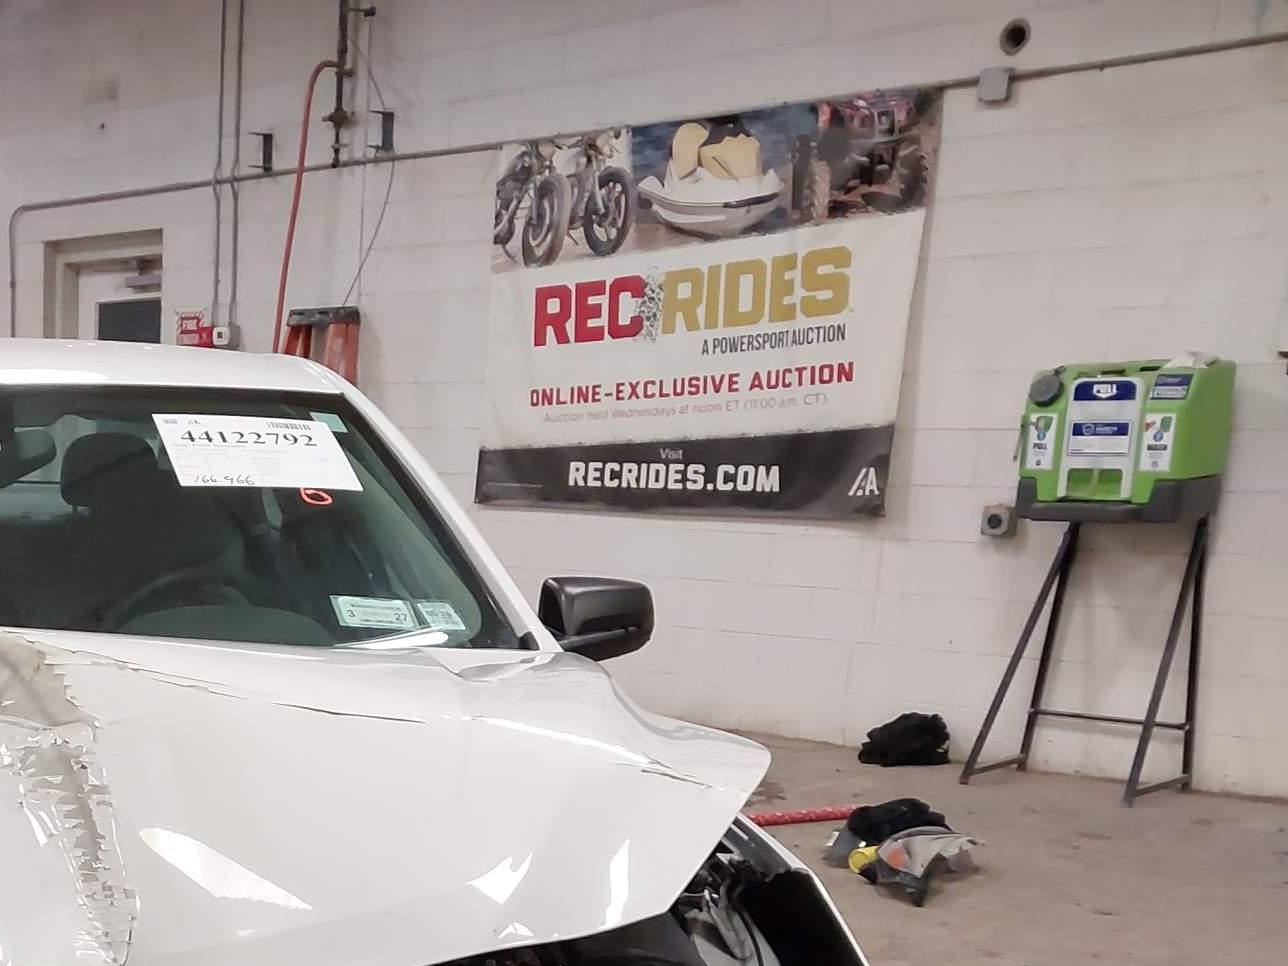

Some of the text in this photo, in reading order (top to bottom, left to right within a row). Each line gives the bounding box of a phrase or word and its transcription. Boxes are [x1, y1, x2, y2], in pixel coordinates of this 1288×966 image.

[534, 245, 852, 347] REC RIDES
[701, 323, 846, 356] A POWERSPORT AUCTION
[530, 361, 854, 407] ONLINE-EXCLUSIVE AUCTION
[543, 411, 584, 423] Auction
[692, 402, 722, 414] noon
[725, 399, 740, 412] ET
[803, 393, 829, 406] CT)
[180, 429, 318, 447] 44122792
[660, 448, 684, 460] Visit
[568, 461, 780, 492] RECRIDES.COM
[346, 609, 355, 618] 3
[394, 612, 407, 622] 27
